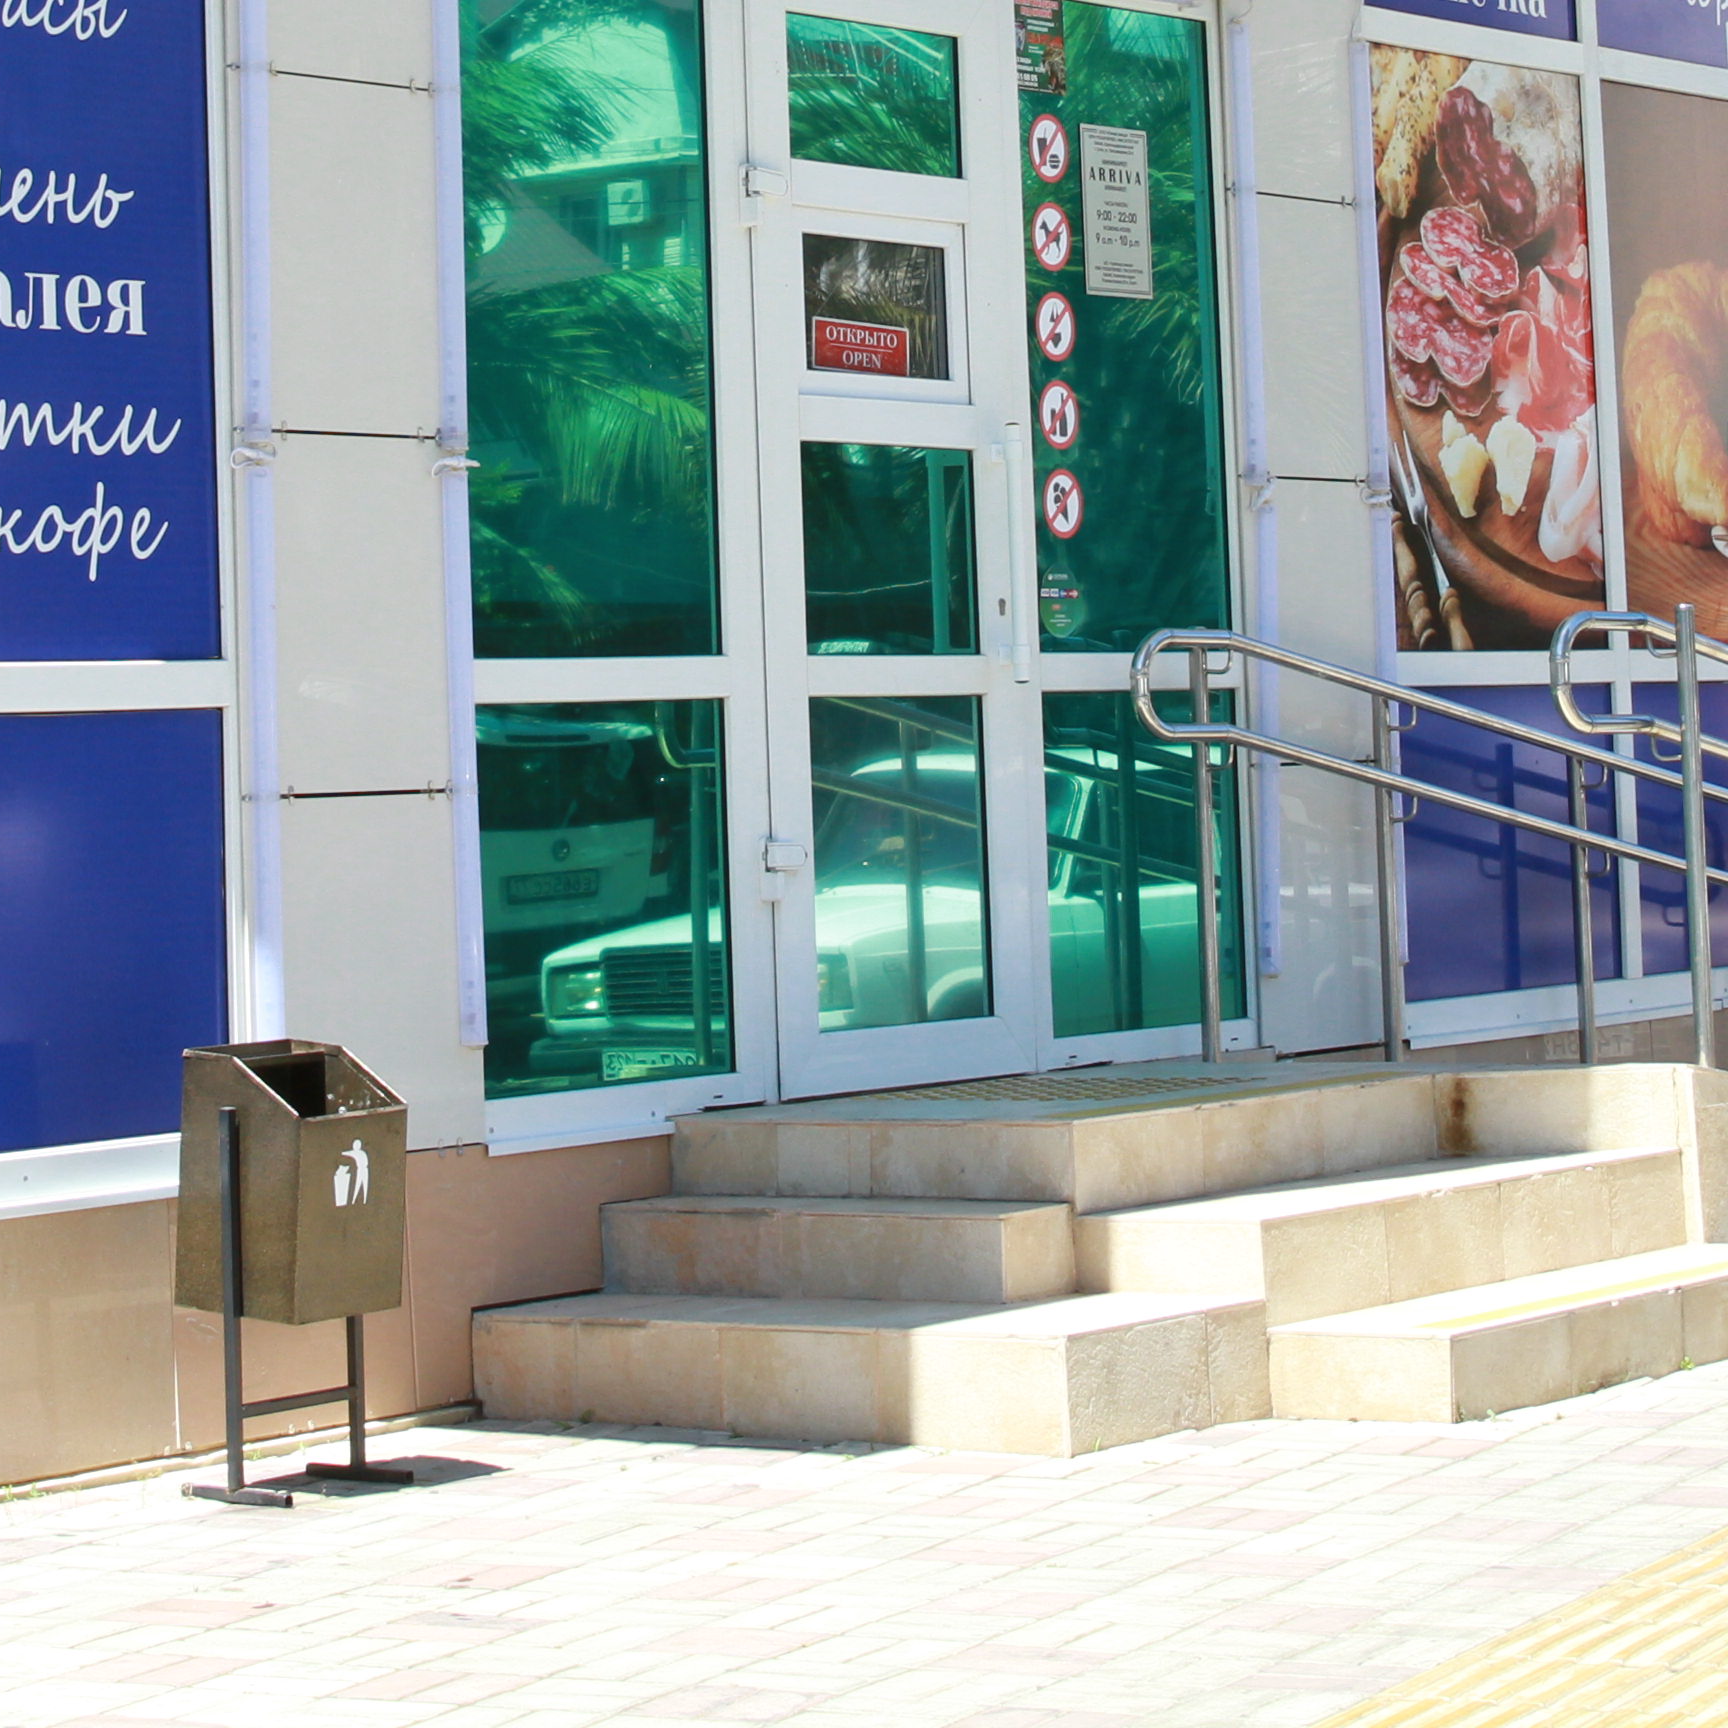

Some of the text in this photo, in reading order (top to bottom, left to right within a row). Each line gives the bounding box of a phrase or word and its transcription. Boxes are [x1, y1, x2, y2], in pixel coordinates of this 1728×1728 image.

[1089, 166, 1142, 186] ARRIVA
[826, 325, 898, 349] ОТКРЫТО
[842, 350, 882, 369] OPEN
